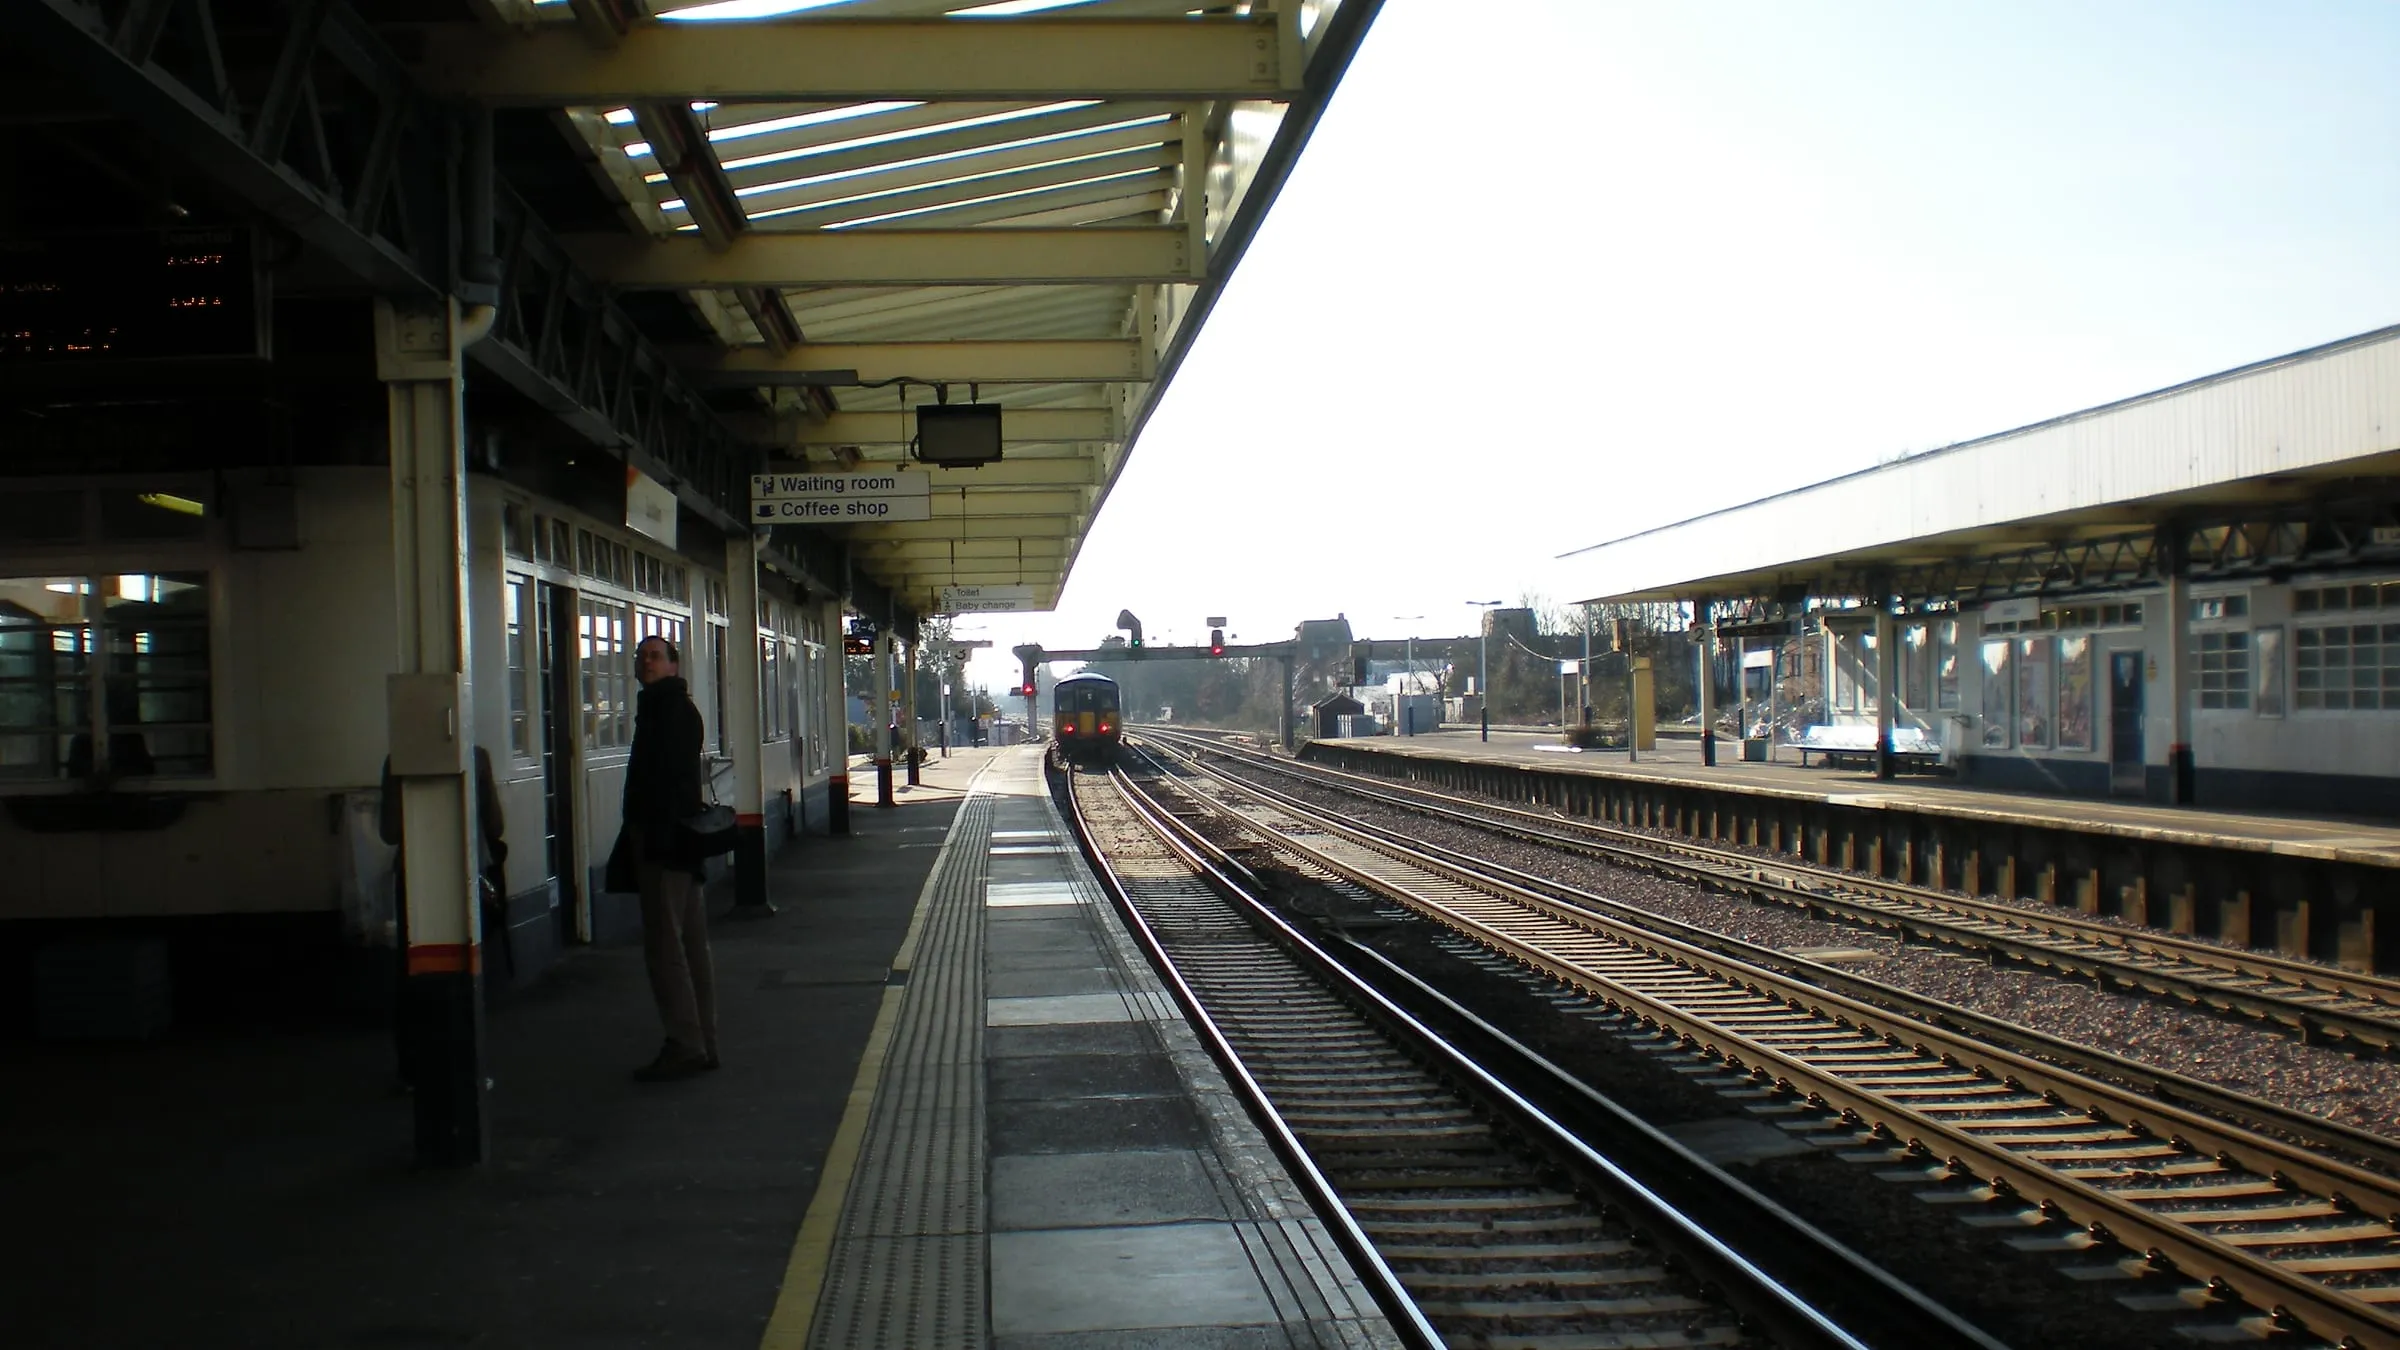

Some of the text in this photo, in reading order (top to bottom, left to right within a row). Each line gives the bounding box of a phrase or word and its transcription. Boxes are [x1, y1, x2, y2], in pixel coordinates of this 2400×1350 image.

[781, 477, 895, 493] Waiting room
[781, 501, 889, 517] Coffee shop
[957, 588, 980, 597] Toilet
[956, 601, 1016, 611] Baby change
[852, 622, 876, 633] 2-4
[1695, 627, 1705, 642] 2
